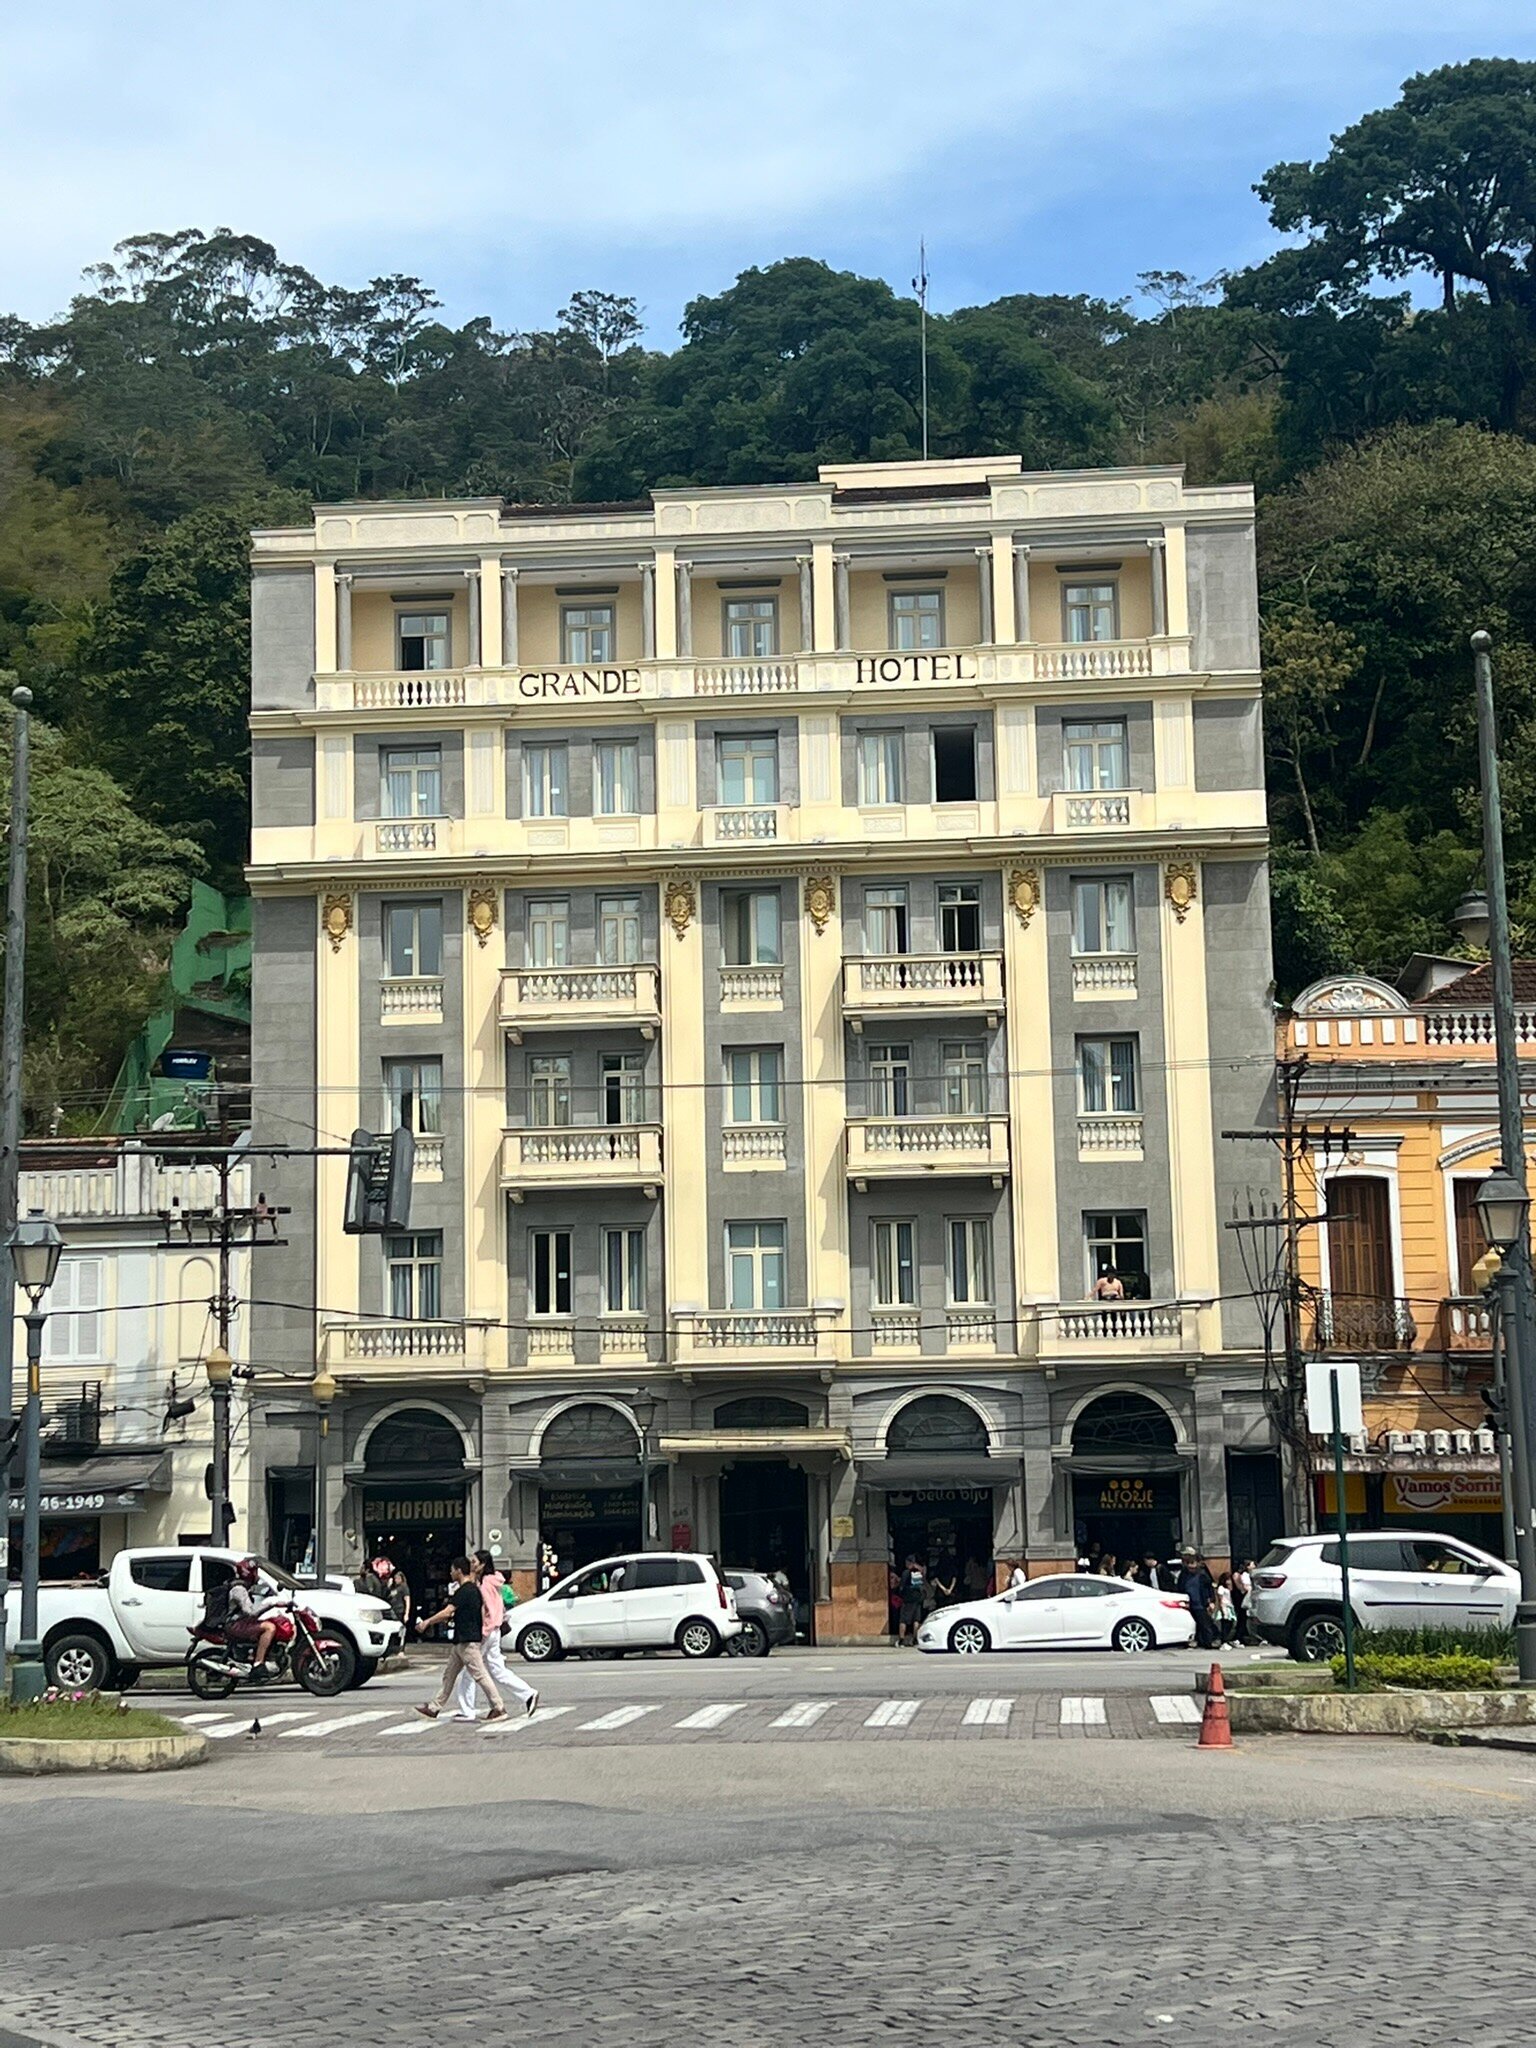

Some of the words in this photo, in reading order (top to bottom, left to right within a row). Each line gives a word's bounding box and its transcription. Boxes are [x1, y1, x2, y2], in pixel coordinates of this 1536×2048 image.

[518, 669, 642, 698] GRANDE
[856, 654, 977, 683] HOTEL
[1397, 1478, 1451, 1493] Vamos
[1100, 1489, 1154, 1503] ALFORJE
[386, 1500, 463, 1520] FIOFORTE
